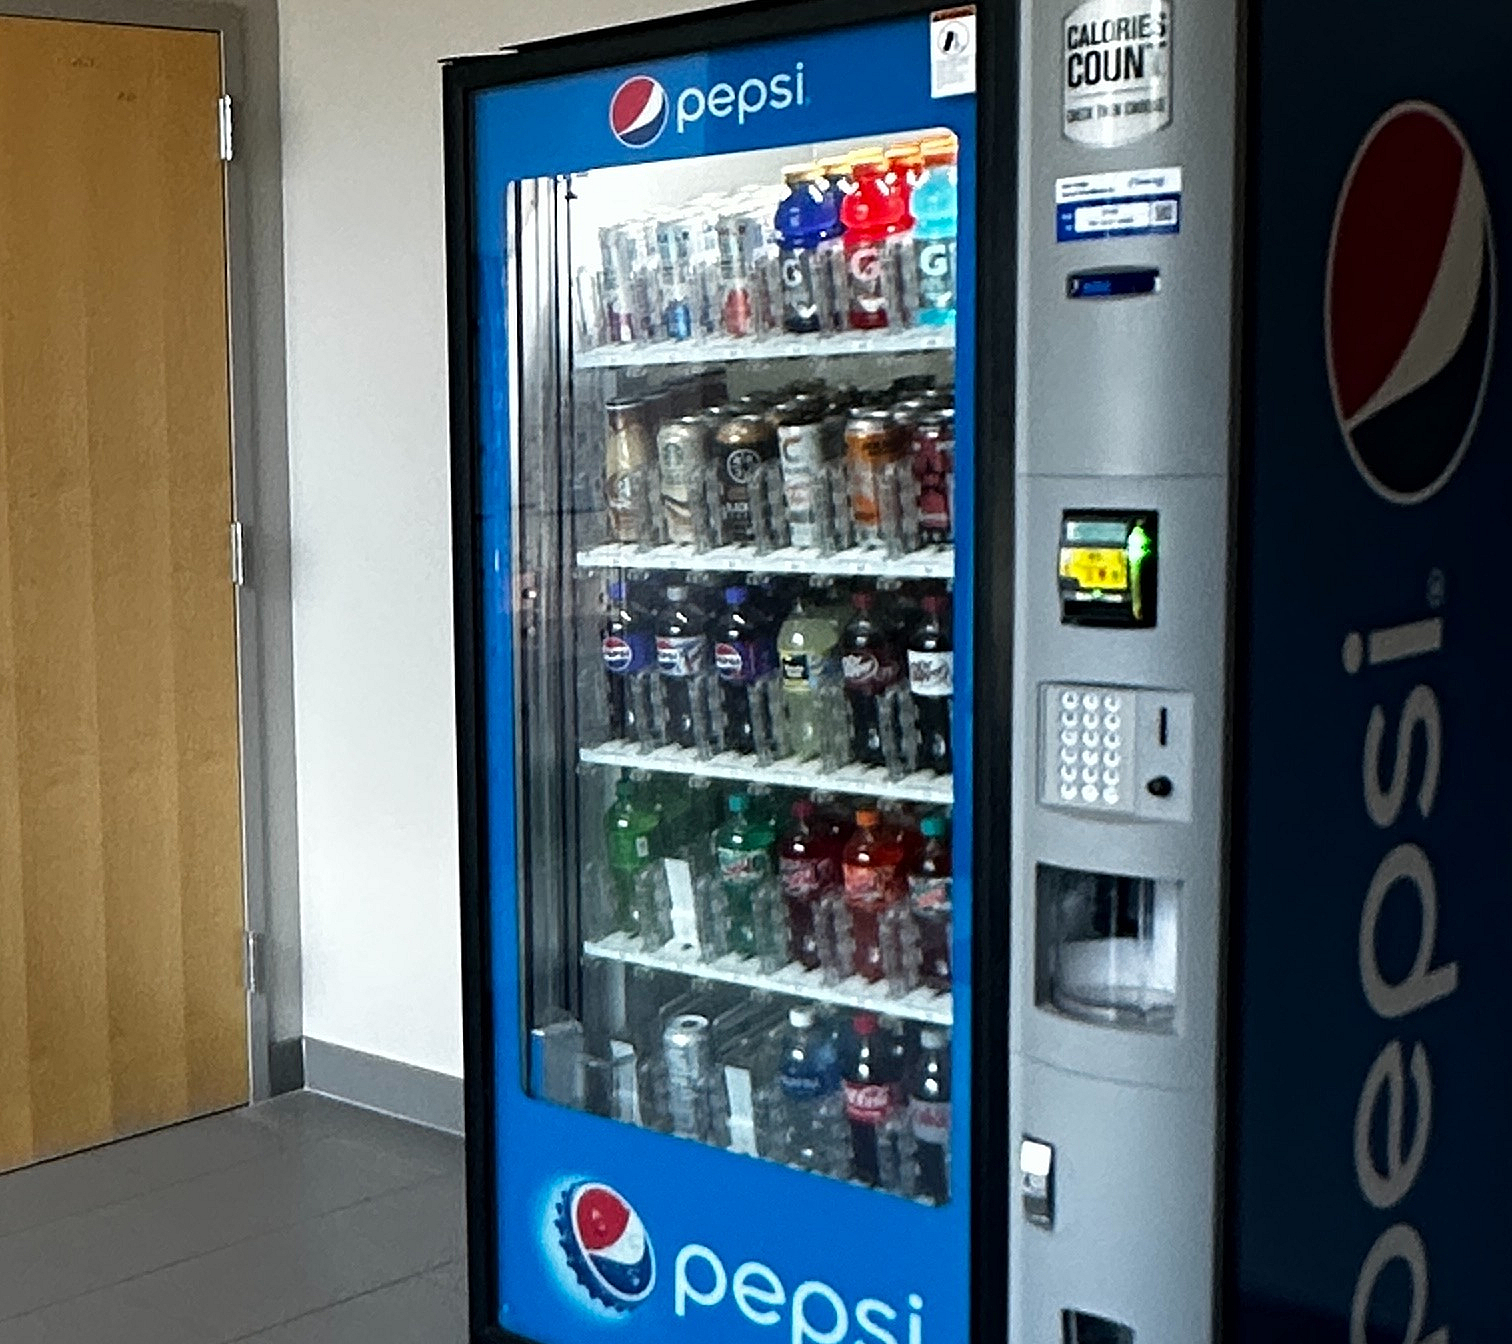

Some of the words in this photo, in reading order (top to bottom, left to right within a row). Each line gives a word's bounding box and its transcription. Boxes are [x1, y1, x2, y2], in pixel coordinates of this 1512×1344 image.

[676, 62, 805, 134] pepsi
[783, 259, 803, 287] G
[851, 247, 880, 281] G
[920, 244, 948, 276] G
